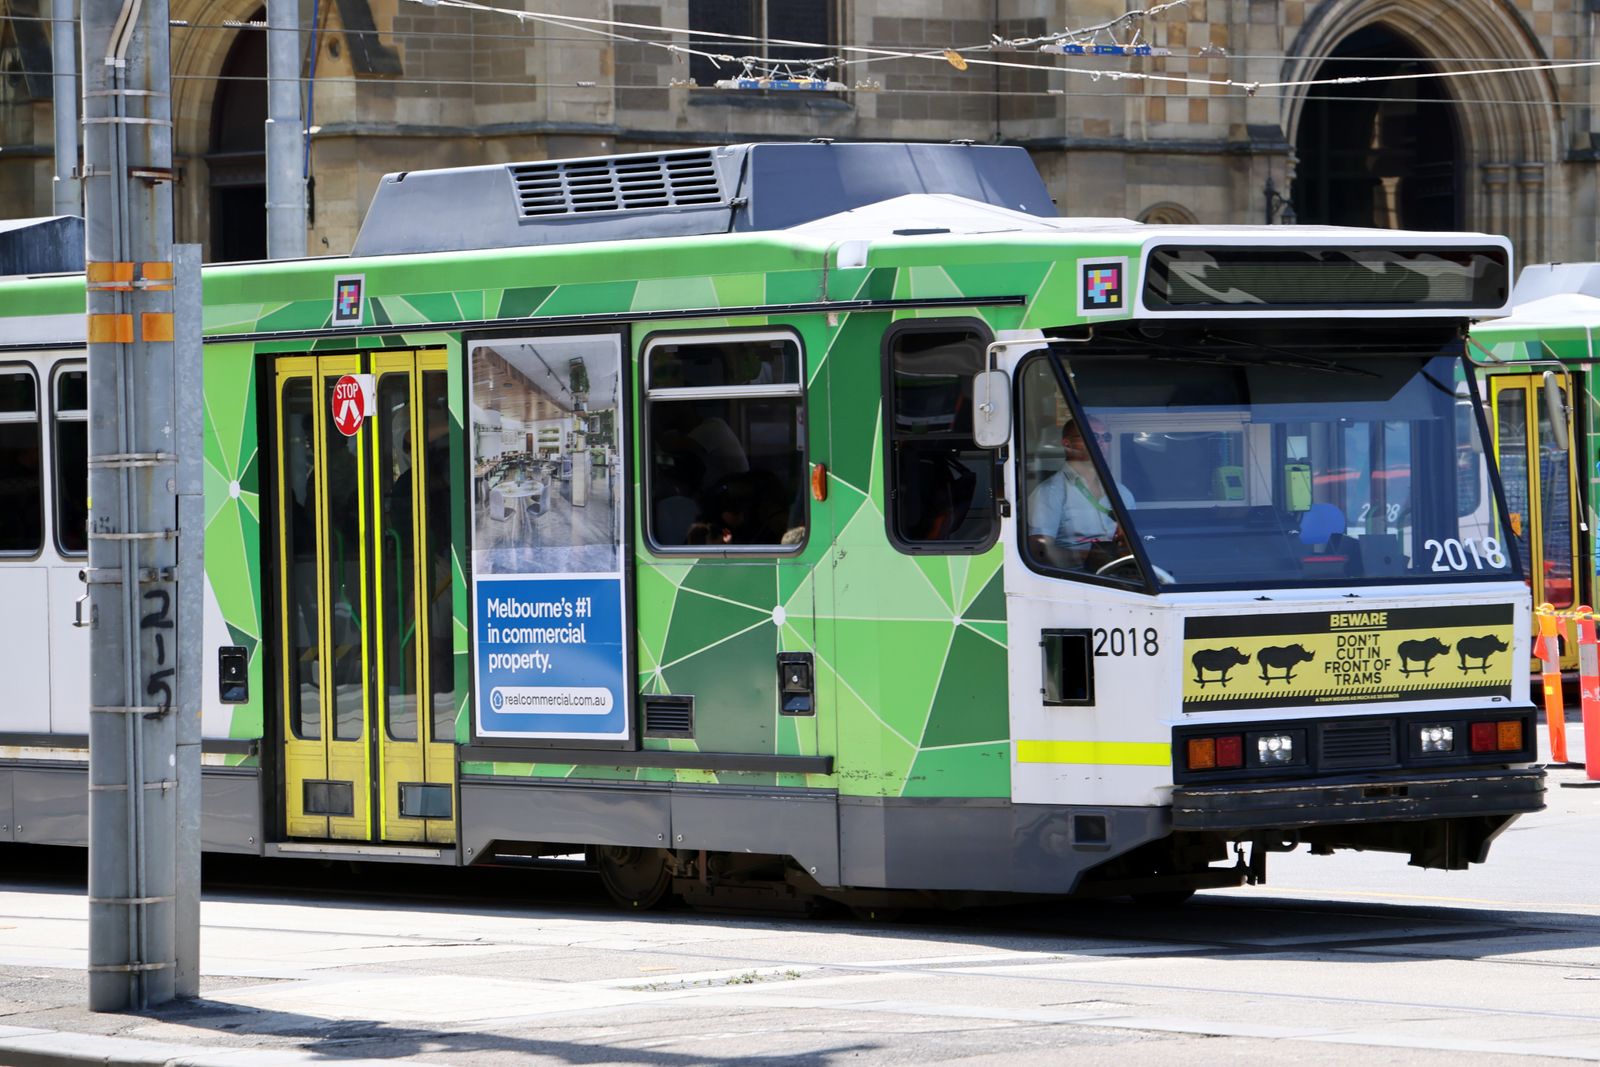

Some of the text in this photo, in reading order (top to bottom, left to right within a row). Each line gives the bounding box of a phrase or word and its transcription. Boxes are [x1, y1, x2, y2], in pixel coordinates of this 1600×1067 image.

[336, 382, 358, 399] STOP
[1357, 503, 1400, 523] 28
[1424, 537, 1506, 572] 2018
[487, 597, 591, 618] Melbourne’s #1
[1330, 612, 1388, 627] BEWARE
[487, 622, 586, 643] in commercial
[1337, 634, 1380, 647] DON’T
[1093, 627, 1159, 656] 2018
[488, 650, 552, 673] property.
[1336, 647, 1380, 660] CUT IN
[1324, 659, 1391, 673] FRONT OF
[1334, 672, 1382, 686] TRAMS
[504, 693, 606, 706] realcommercial.com.au
